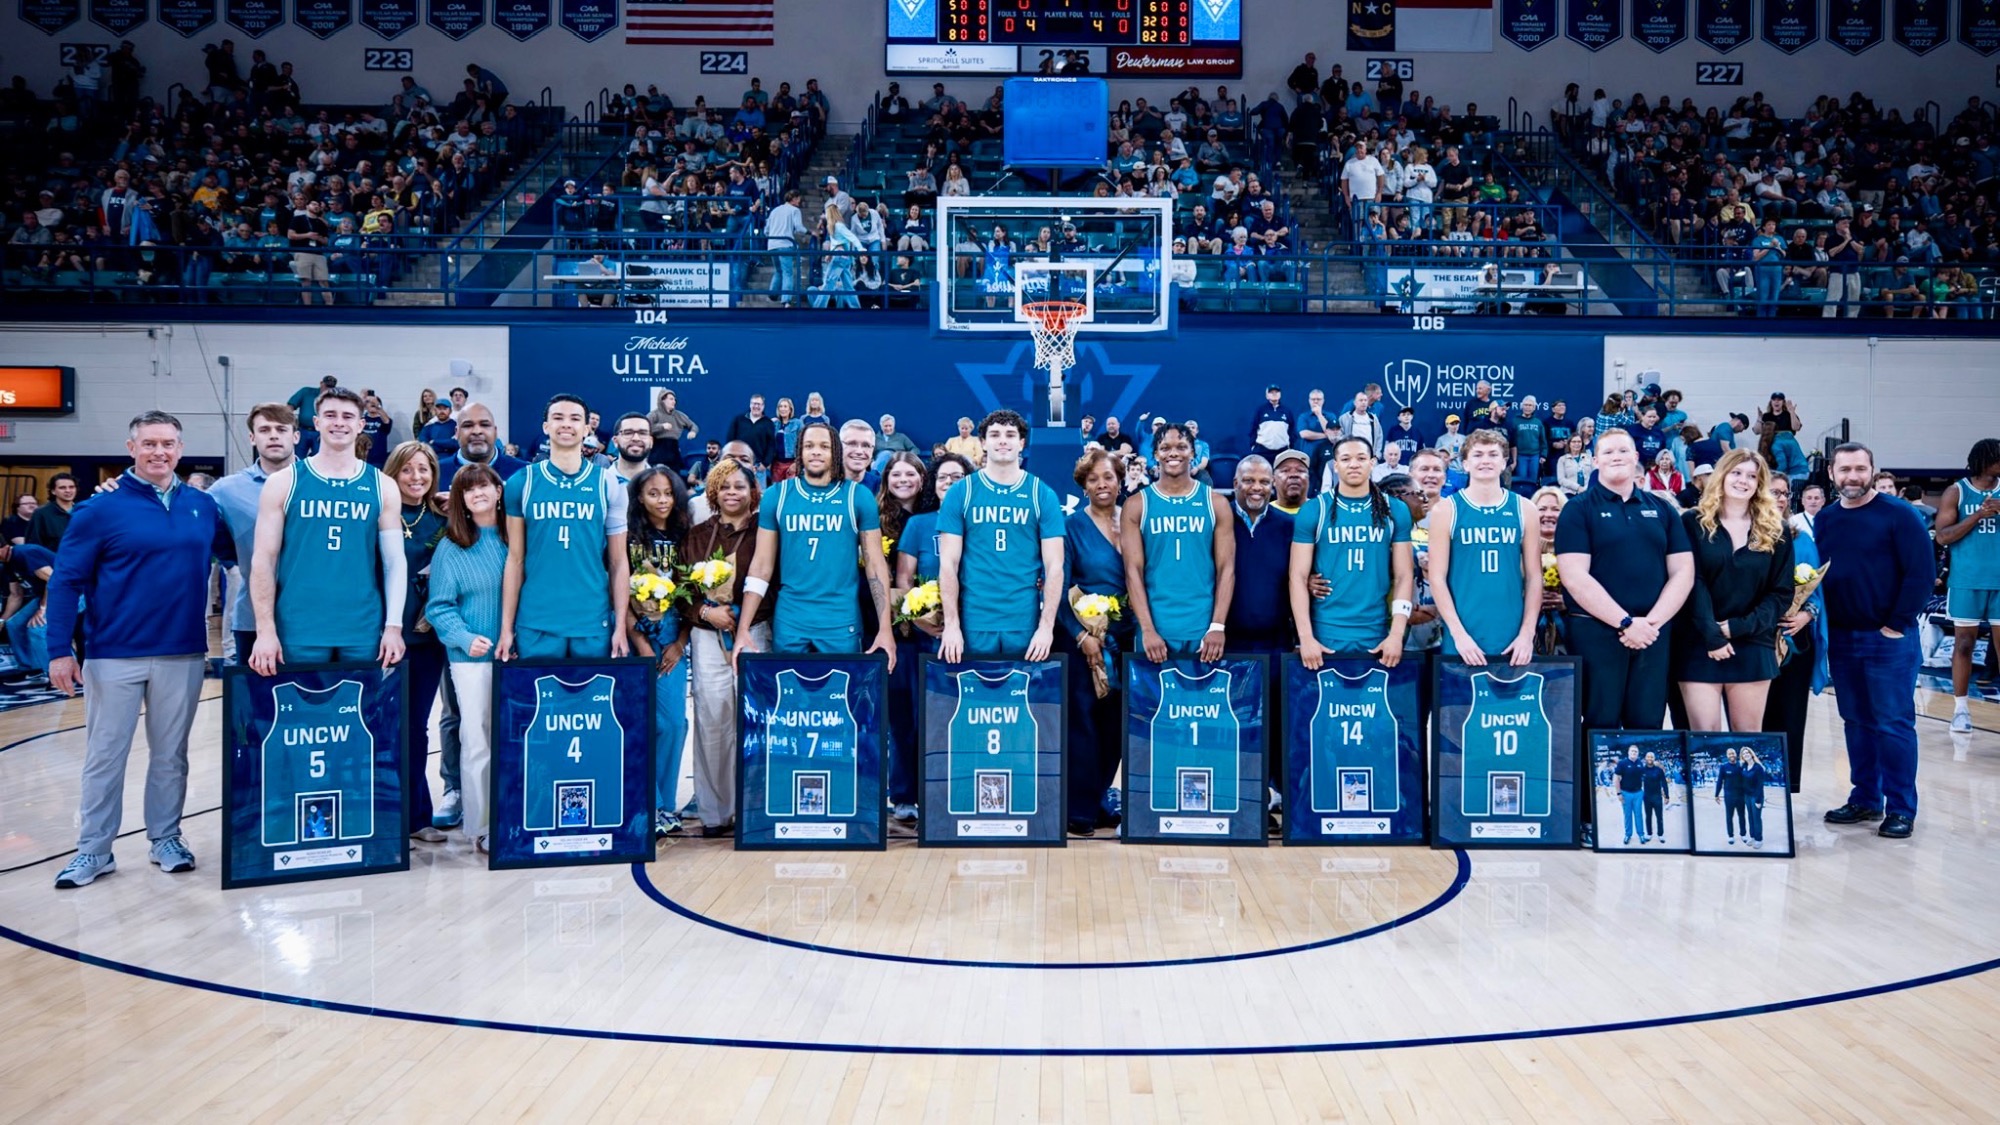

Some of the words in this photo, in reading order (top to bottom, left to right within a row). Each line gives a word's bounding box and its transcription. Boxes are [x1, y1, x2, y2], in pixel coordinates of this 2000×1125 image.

[1149, 1, 1157, 12] 6
[1161, 1, 1168, 12] 0
[1179, 1, 1187, 12] 0
[511, 23, 534, 31] 1998
[578, 24, 600, 32] 1997
[950, 14, 957, 24] 7
[960, 14, 968, 25] 0
[979, 14, 987, 25] 0
[1005, 18, 1014, 32] 0
[1026, 19, 1036, 31] 4
[1093, 19, 1103, 32] 4
[1118, 19, 1128, 33] 0
[1143, 15, 1157, 27] 32
[1161, 15, 1168, 27] 0
[1179, 15, 1187, 27] 0
[949, 28, 957, 40] 8
[960, 28, 968, 41] 0
[979, 28, 987, 41] 0
[1142, 30, 1157, 42] 82
[1160, 30, 1168, 42] 0
[1179, 30, 1187, 42] 0
[1517, 34, 1540, 42] 2000
[1583, 34, 1606, 42] 2002
[1647, 36, 1671, 44] 2003
[1844, 38, 1866, 46] 2017
[62, 46, 109, 64] 22
[367, 51, 411, 68] 223
[702, 53, 746, 72] 224
[1116, 51, 1185, 69] Deuterman
[1698, 65, 1741, 82] 227
[635, 309, 668, 324] 104
[1412, 316, 1445, 330] 106
[624, 335, 690, 351] Michelob
[1436, 365, 1515, 381] HORTON
[1436, 382, 1515, 398] MENEZ
[300, 500, 371, 521] UNCW
[533, 501, 595, 521] UNCW
[972, 505, 1030, 525] UNCW
[785, 513, 844, 531] UNCW
[1150, 515, 1205, 535] UNCW
[1978, 518, 1996, 534] 35
[328, 526, 342, 550] 5
[559, 526, 570, 550] 4
[996, 529, 1006, 551] 8
[1328, 525, 1385, 544] UNCW
[1460, 526, 1518, 545] UNCW
[808, 537, 819, 560] 7
[1175, 539, 1181, 560] 1
[1347, 549, 1364, 571] 14
[1481, 550, 1499, 572] 10
[592, 694, 610, 702] CAA
[338, 705, 358, 714] CAA
[967, 707, 1019, 724] UNCW
[1169, 703, 1221, 719] UNCW
[1328, 703, 1376, 718] UNCW
[545, 713, 602, 732] UNCW
[786, 711, 840, 728] UNCW
[1481, 711, 1531, 729] UNCW
[283, 724, 350, 746] UNCW
[988, 729, 1001, 754] 8
[1190, 722, 1198, 746] 1
[1341, 721, 1364, 745] 14
[566, 736, 582, 764] 4
[807, 733, 819, 758] 7
[1492, 730, 1518, 756] 10
[310, 751, 326, 777] 5
